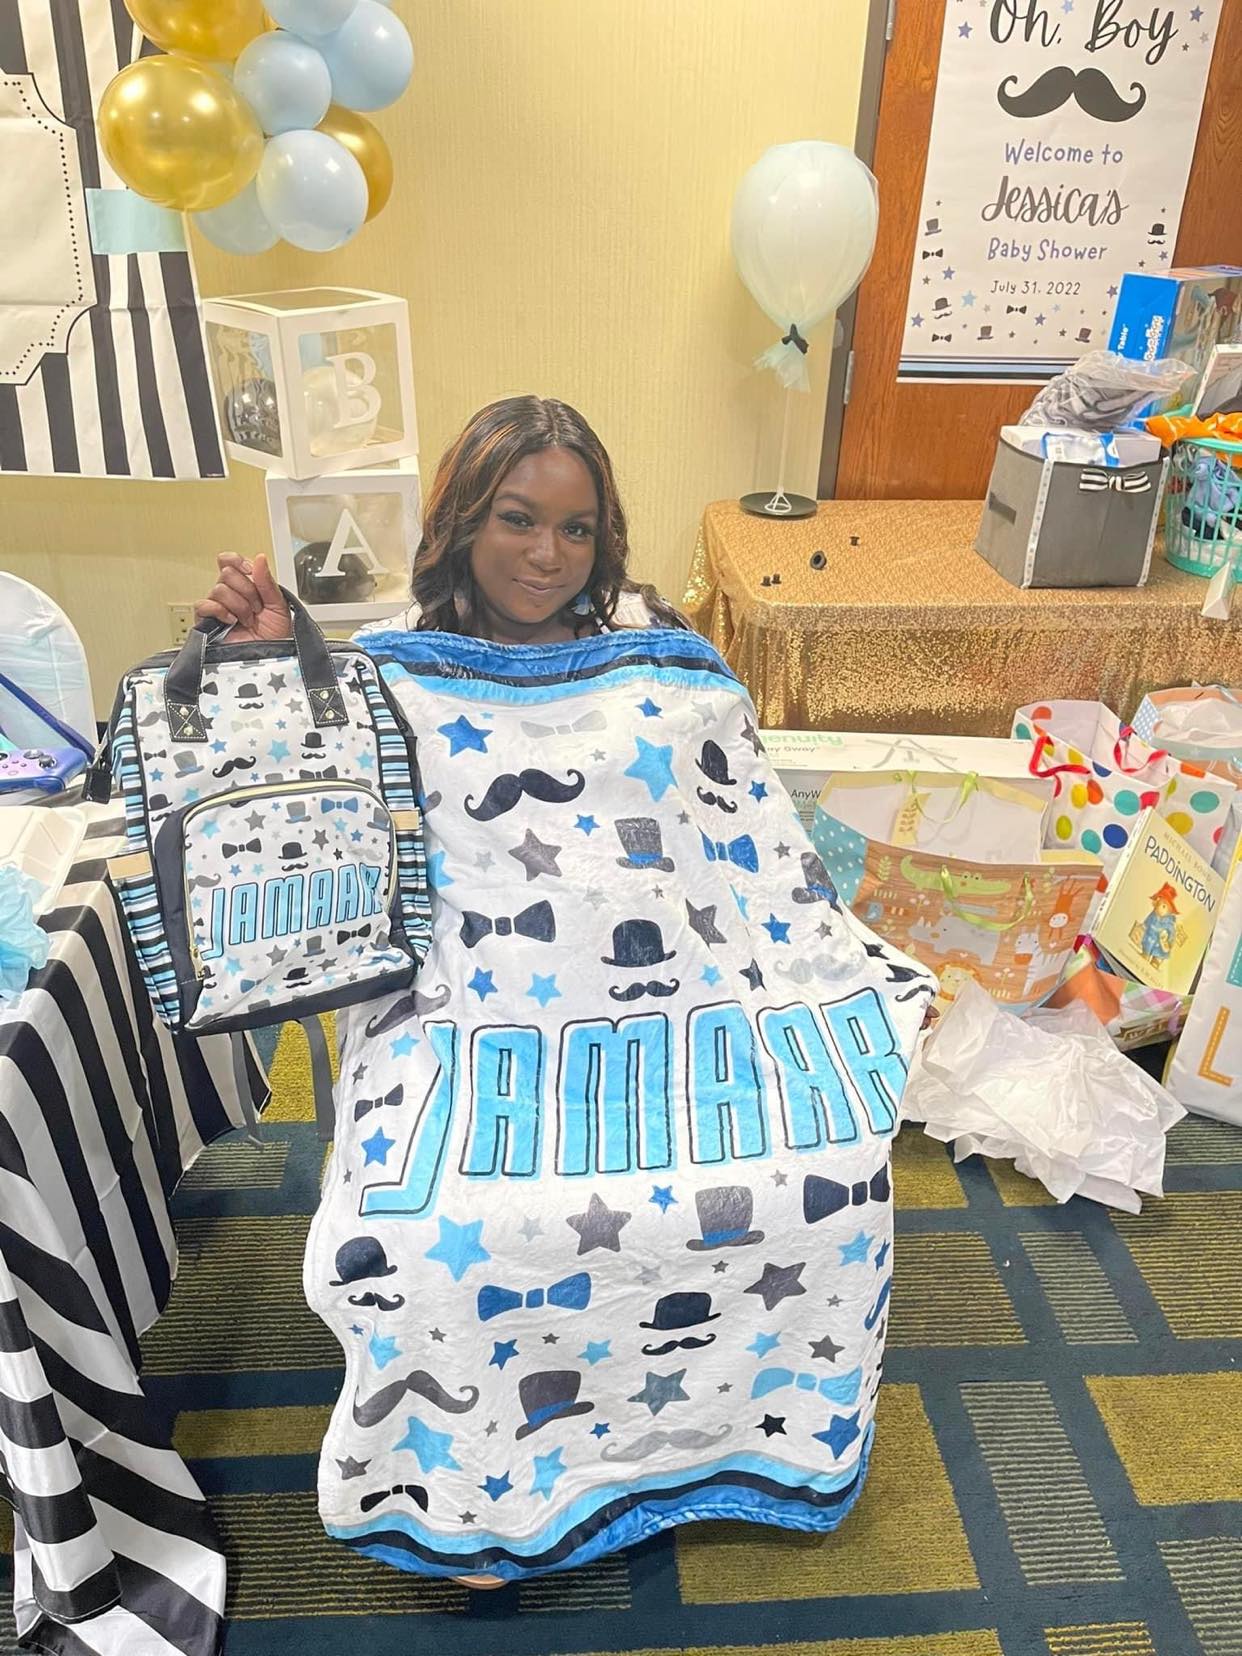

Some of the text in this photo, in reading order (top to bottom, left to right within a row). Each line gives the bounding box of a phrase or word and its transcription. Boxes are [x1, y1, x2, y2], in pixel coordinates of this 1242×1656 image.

[1085, 0, 1179, 65] Boy
[1004, 138, 1124, 165] Welcome to
[981, 175, 1130, 226] Jessica's
[987, 237, 1108, 262] Baby Shower
[990, 280, 1017, 295] July
[1046, 281, 1081, 295] 2022
[1117, 327, 1128, 350] Table
[326, 351, 381, 429] B
[315, 508, 392, 577] A
[791, 789, 821, 800] AnyW
[200, 862, 383, 962] JAMAAR
[358, 986, 908, 1221] JAMAAR
